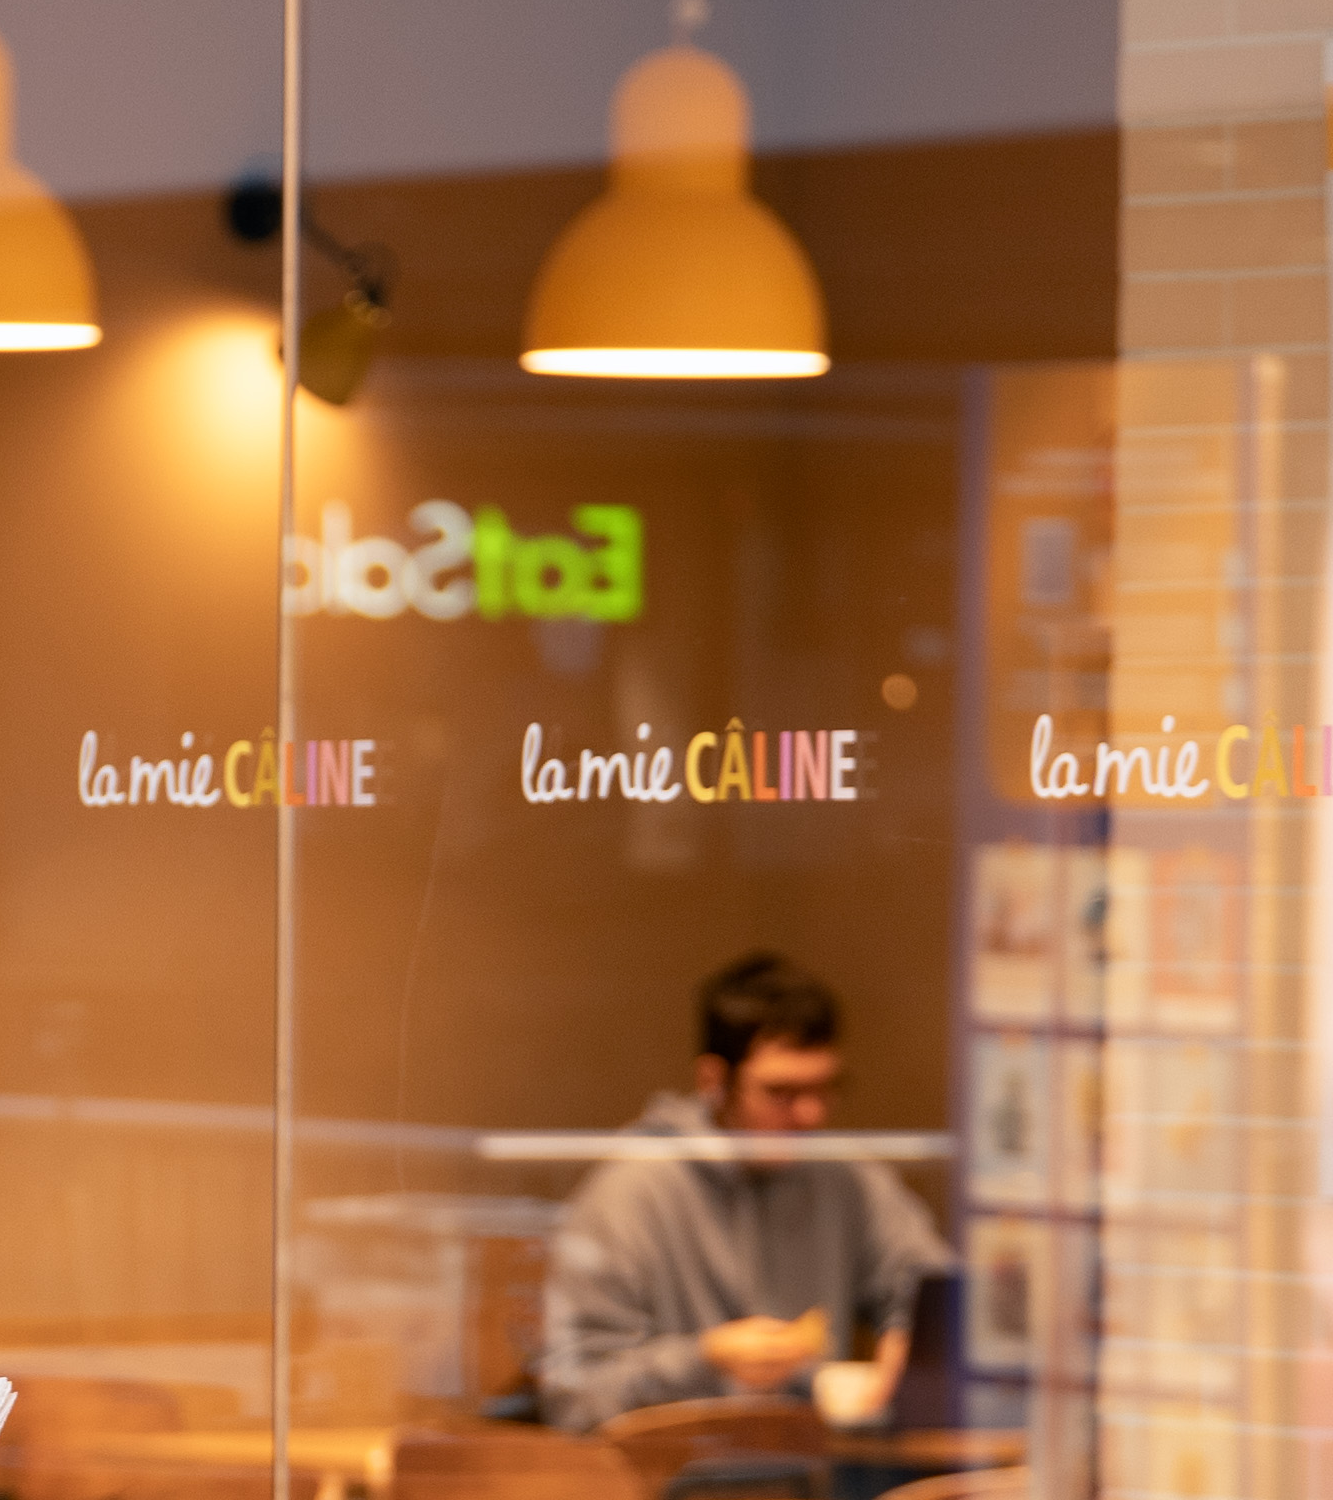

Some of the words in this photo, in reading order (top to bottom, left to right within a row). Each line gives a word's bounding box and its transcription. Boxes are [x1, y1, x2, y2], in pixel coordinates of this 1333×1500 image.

[78, 729, 126, 807] la
[128, 731, 221, 807] mie
[223, 725, 376, 808] CÂLINE
[521, 721, 575, 803] la
[577, 721, 681, 803] mie
[684, 715, 858, 804] CÂLINE
[1030, 712, 1090, 798] la
[1093, 713, 1210, 798] mie
